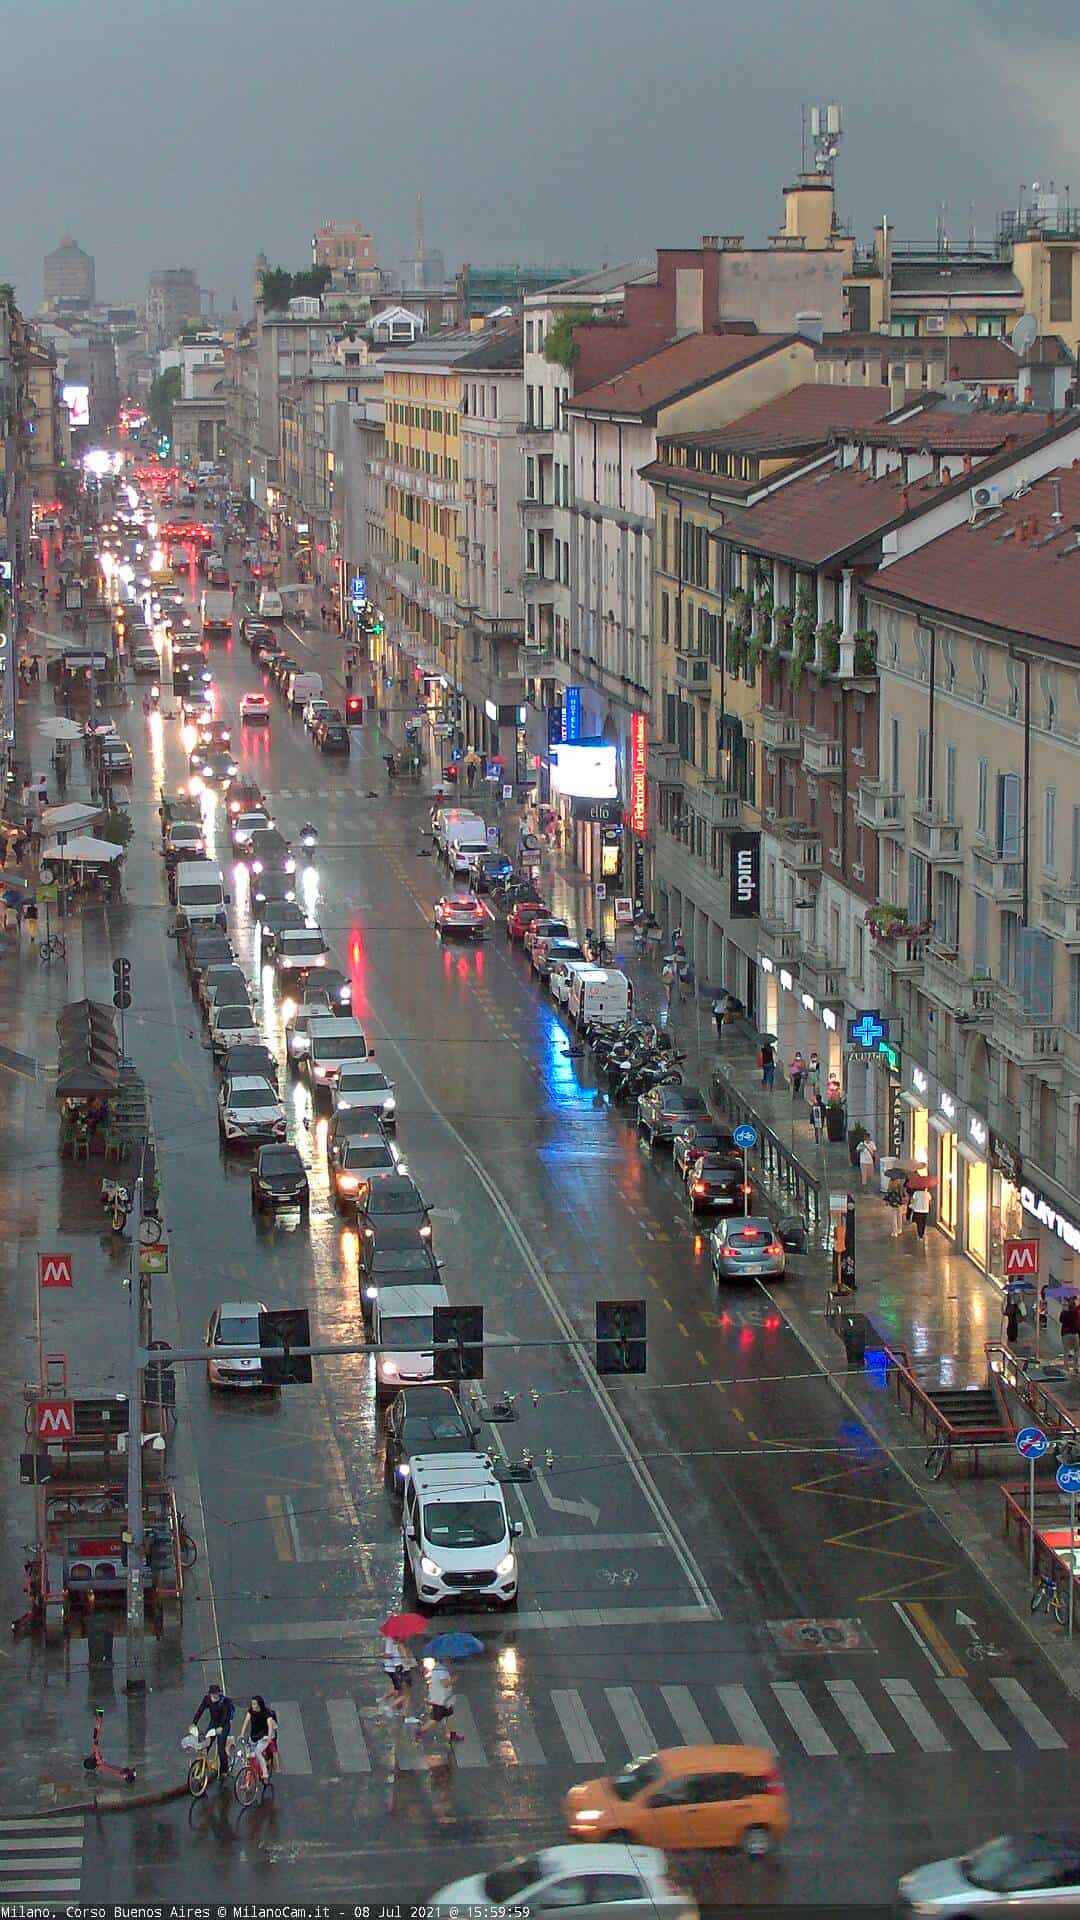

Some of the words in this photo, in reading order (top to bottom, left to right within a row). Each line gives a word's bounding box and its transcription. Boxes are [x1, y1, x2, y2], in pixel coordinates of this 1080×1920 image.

[356, 580, 363, 592] P
[737, 850, 756, 901] upim
[1007, 1248, 1034, 1268] M
[43, 1262, 71, 1281] M
[39, 1408, 71, 1431] M
